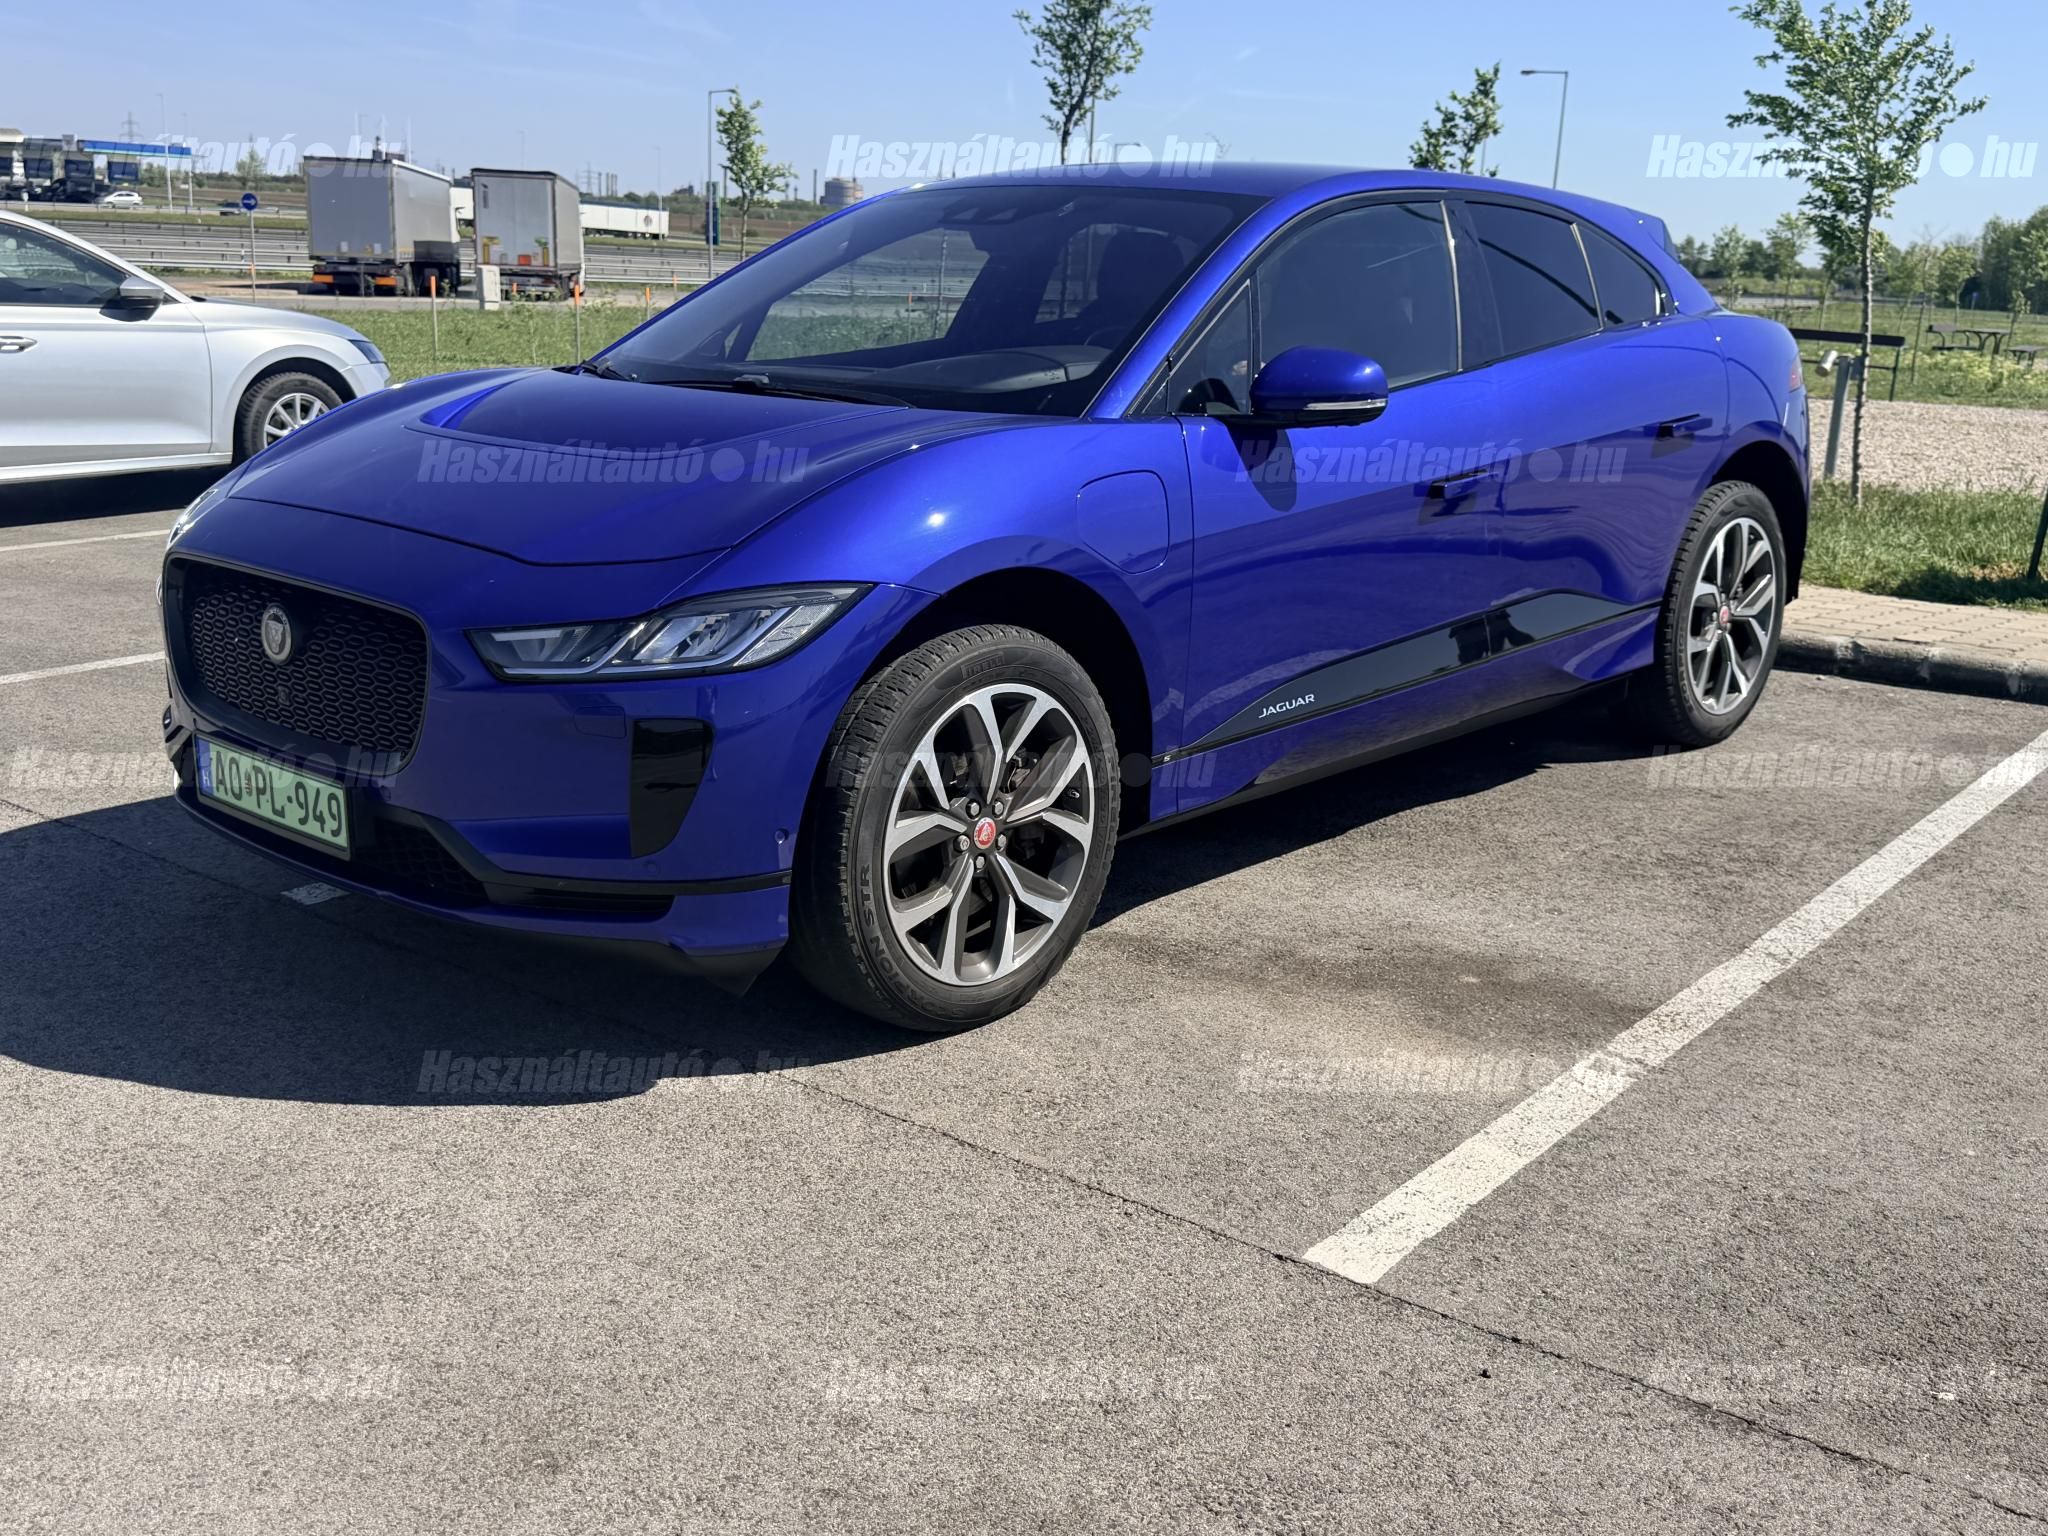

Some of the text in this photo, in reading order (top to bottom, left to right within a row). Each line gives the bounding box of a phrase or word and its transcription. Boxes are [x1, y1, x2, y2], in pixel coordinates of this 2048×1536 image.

[1258, 693, 1315, 719] JAGUAR
[215, 750, 343, 838] AO PL-949
[856, 863, 875, 929] STR
